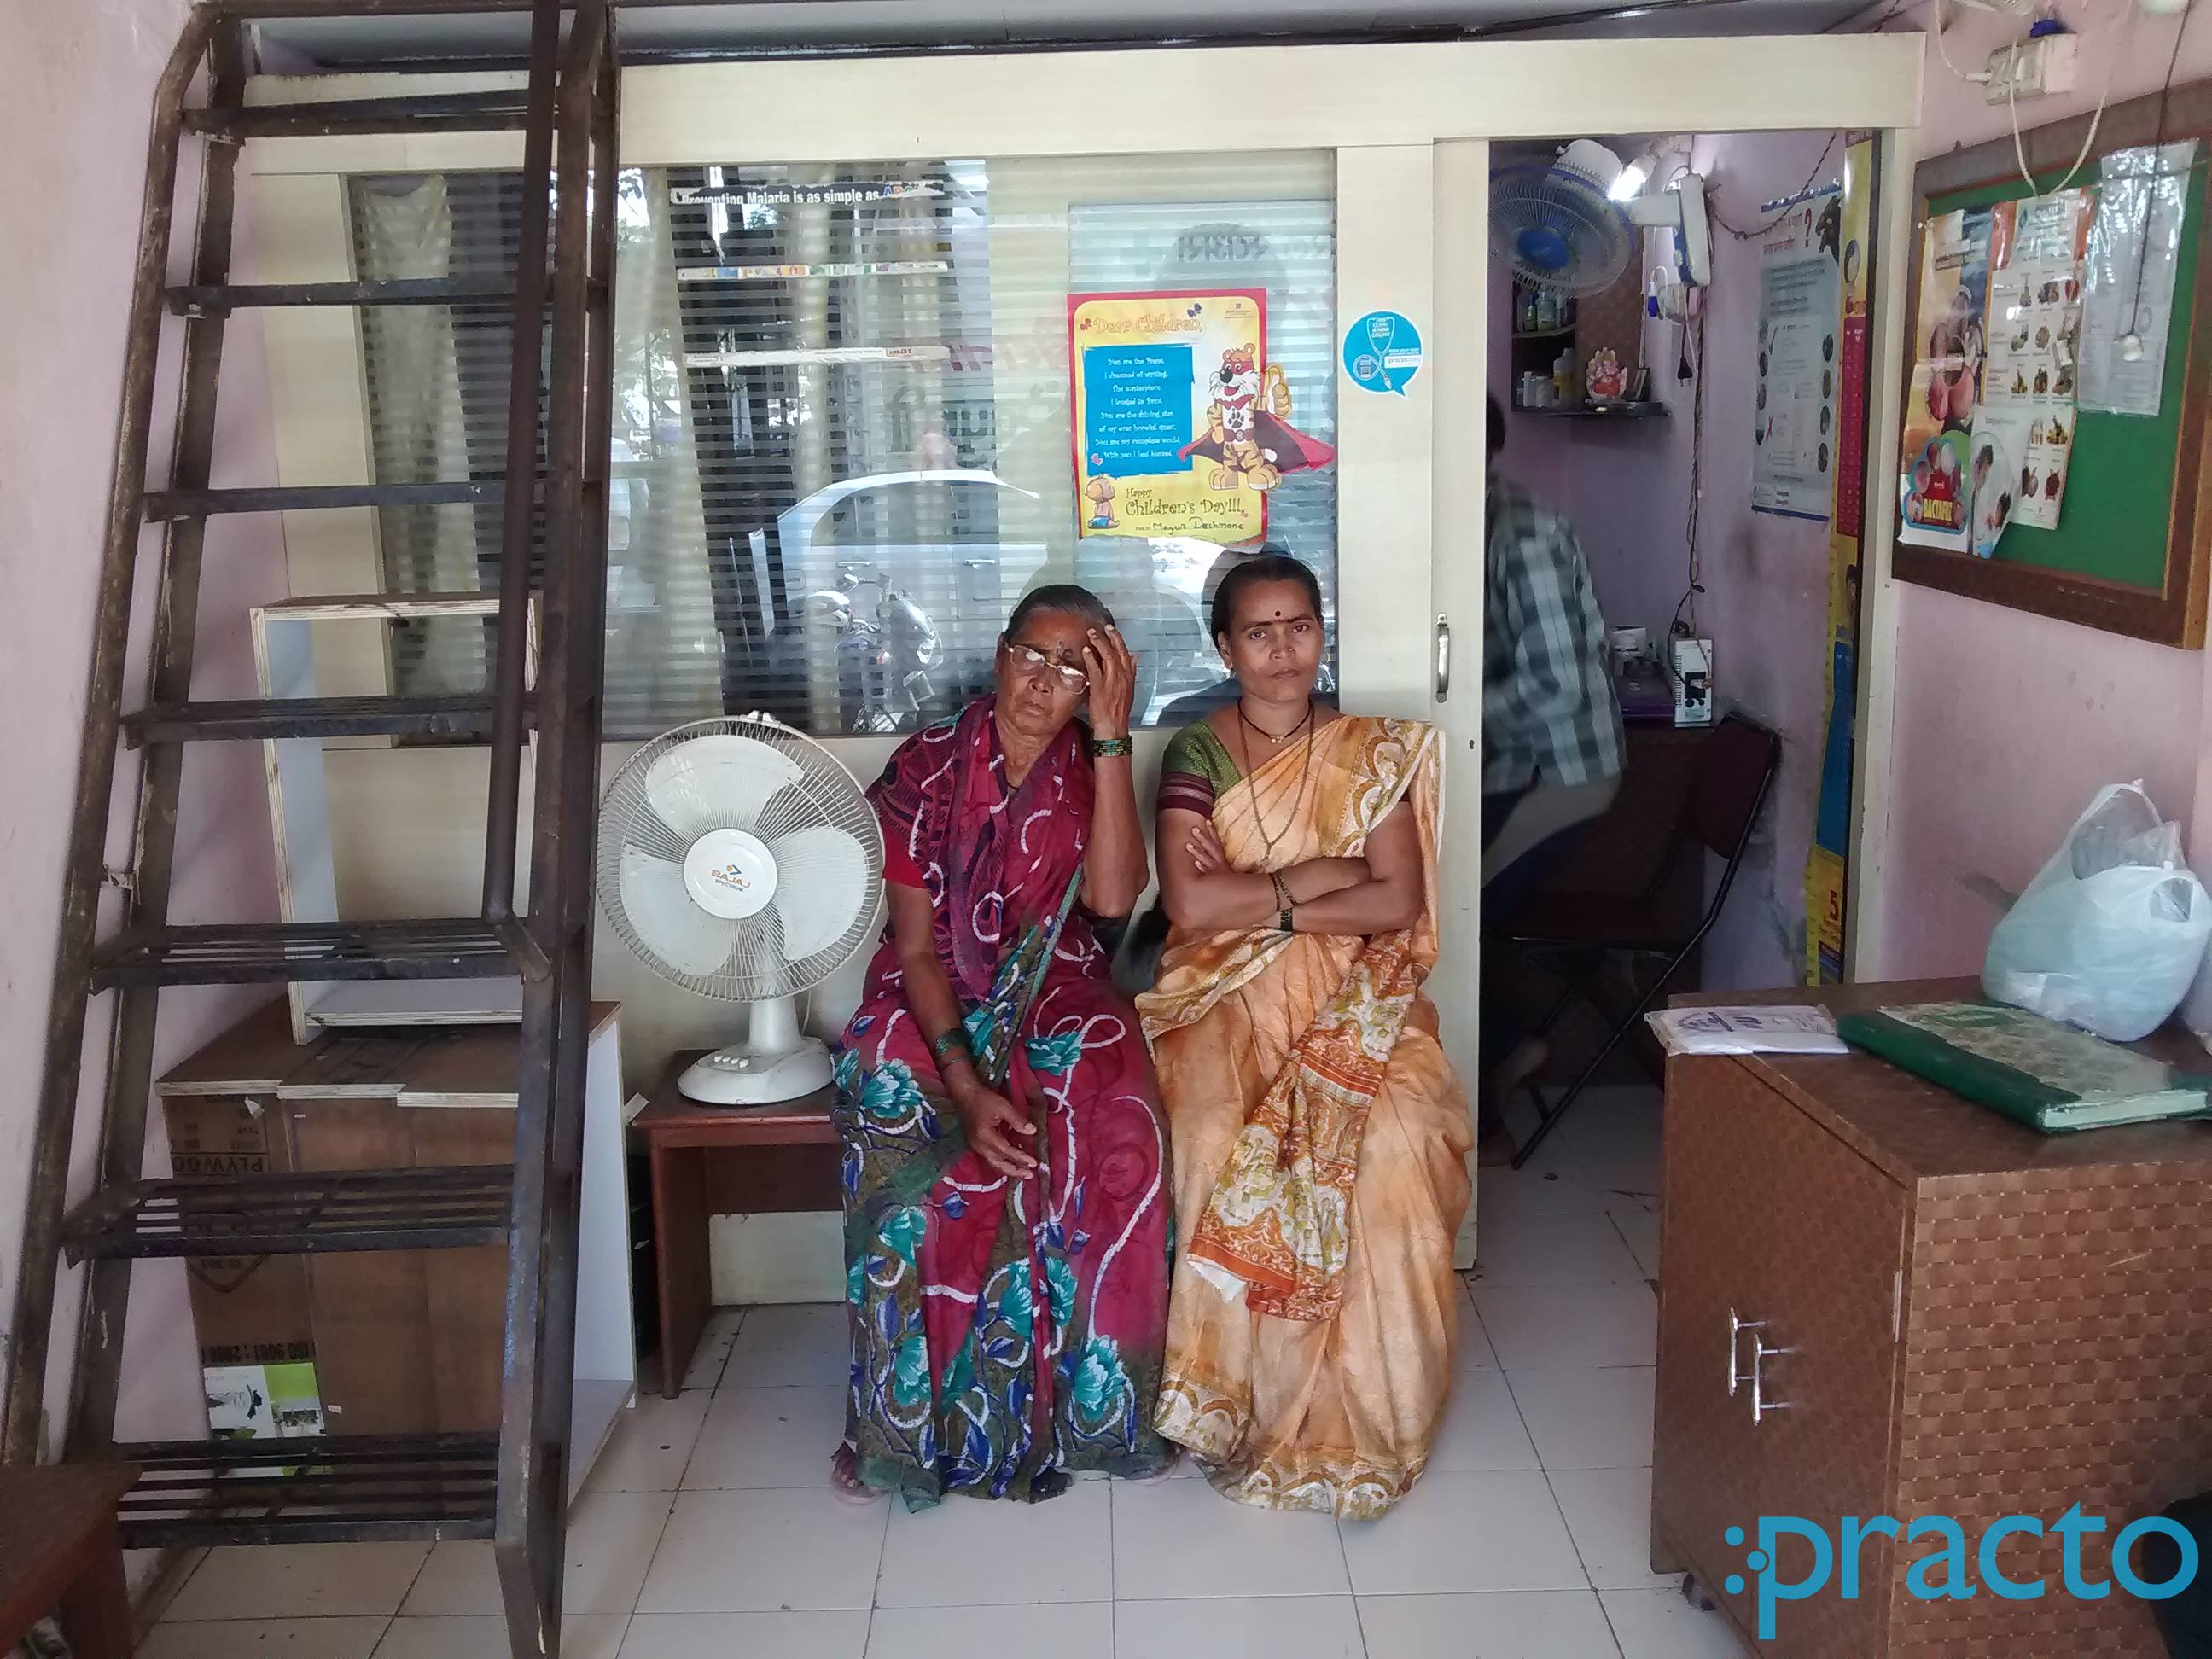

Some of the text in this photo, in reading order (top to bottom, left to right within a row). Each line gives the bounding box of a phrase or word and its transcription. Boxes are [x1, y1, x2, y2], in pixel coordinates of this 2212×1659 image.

[747, 190, 790, 204] Malaria
[793, 189, 804, 203] is
[806, 192, 821, 203] as
[824, 188, 863, 205] simple
[865, 190, 880, 201] as
[1126, 487, 1153, 499] Happy
[1125, 498, 1196, 516] Children's
[711, 869, 751, 888] BAJAJ
